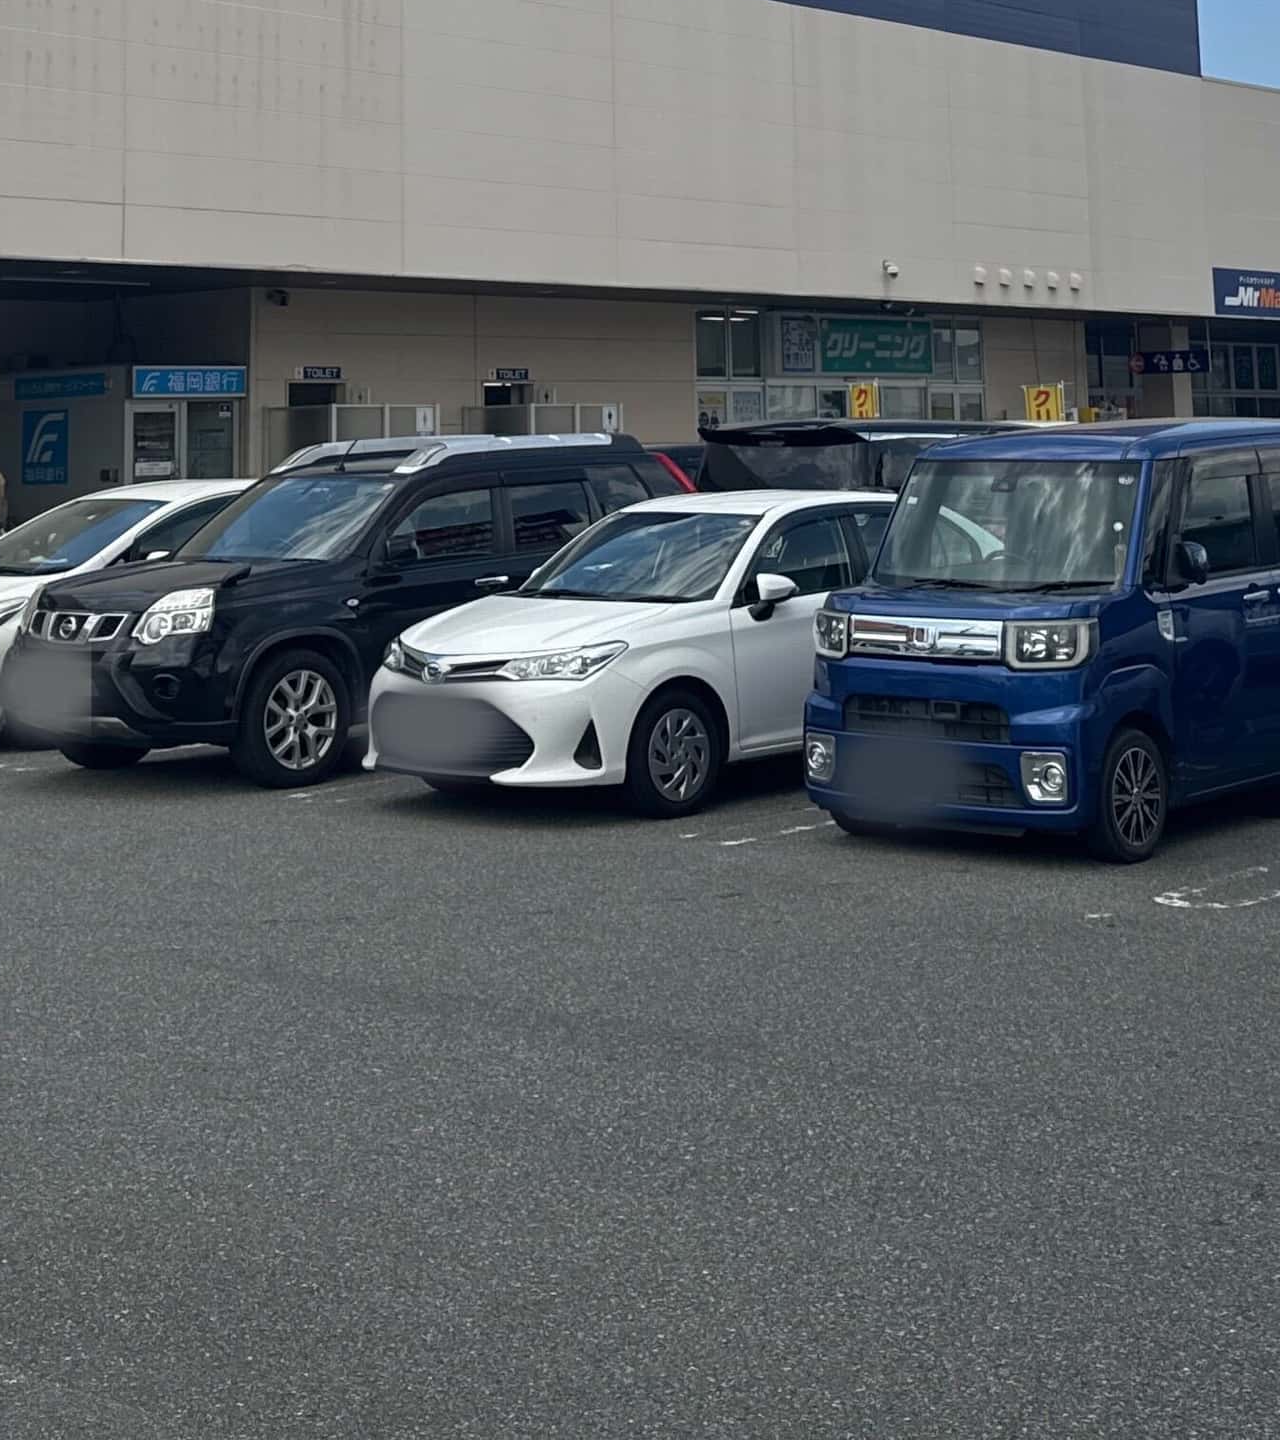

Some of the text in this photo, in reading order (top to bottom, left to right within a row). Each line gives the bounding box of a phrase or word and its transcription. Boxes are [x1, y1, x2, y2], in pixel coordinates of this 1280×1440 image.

[826, 333, 928, 359] クリーニング
[306, 368, 339, 378] TOILET
[499, 369, 527, 379] TOILET
[168, 371, 240, 392] 福岡銀行
